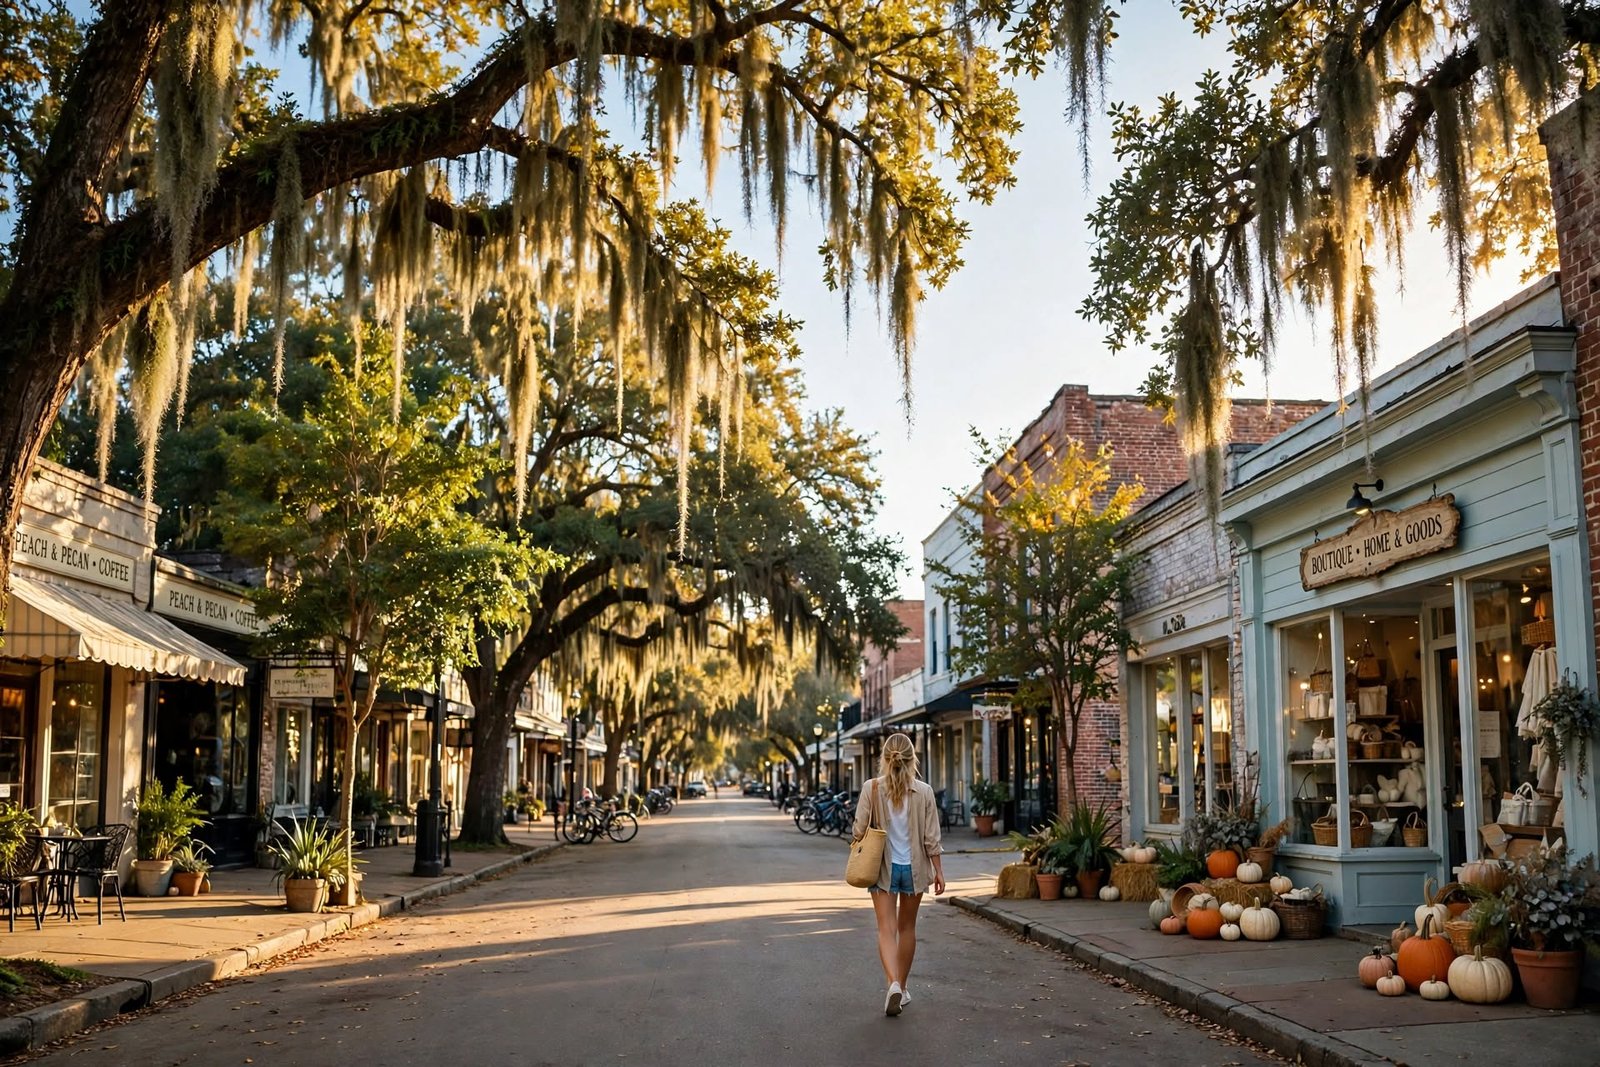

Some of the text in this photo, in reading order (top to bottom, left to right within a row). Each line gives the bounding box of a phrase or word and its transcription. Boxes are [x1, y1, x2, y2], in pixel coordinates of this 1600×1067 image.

[15, 531, 129, 582] PEACH & PECAN COFFEE
[1311, 514, 1443, 575] BOUTIQUE HOME & GOODS
[169, 590, 195, 612] PEACH
[197, 599, 202, 614] &
[205, 601, 228, 621] PECAN
